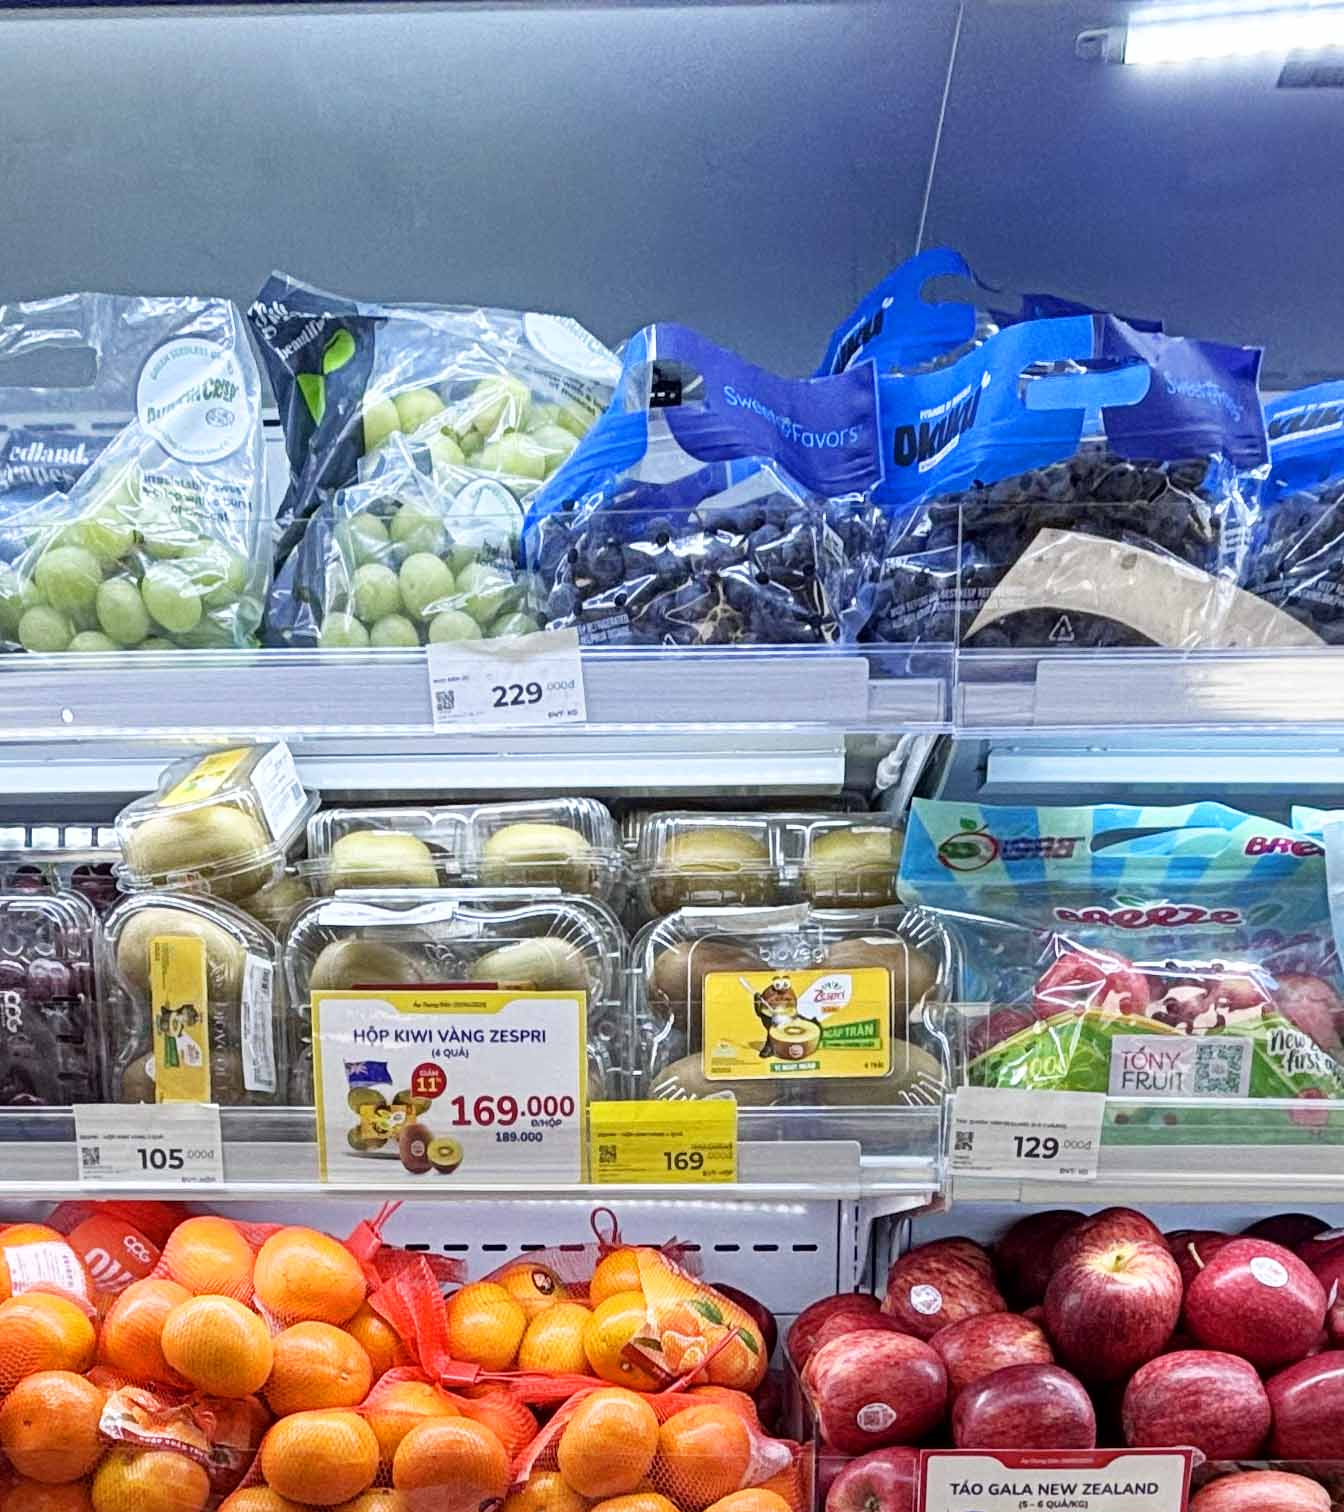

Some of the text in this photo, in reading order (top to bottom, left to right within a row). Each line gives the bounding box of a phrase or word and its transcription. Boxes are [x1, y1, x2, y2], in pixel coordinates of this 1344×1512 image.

[8, 441, 91, 466] edland.
[490, 681, 544, 709] 229
[353, 1025, 547, 1047] HỘP KIWI VÀNG ZESPRI
[1121, 1070, 1184, 1091] FRUIT
[450, 1095, 575, 1127] 169.000
[495, 1131, 544, 1144] 189.000
[1012, 1134, 1059, 1159] 129
[135, 1146, 185, 1170] 105
[663, 1151, 704, 1171] 169
[950, 1479, 1159, 1496] TÁO GALA NEW ZEALAND
